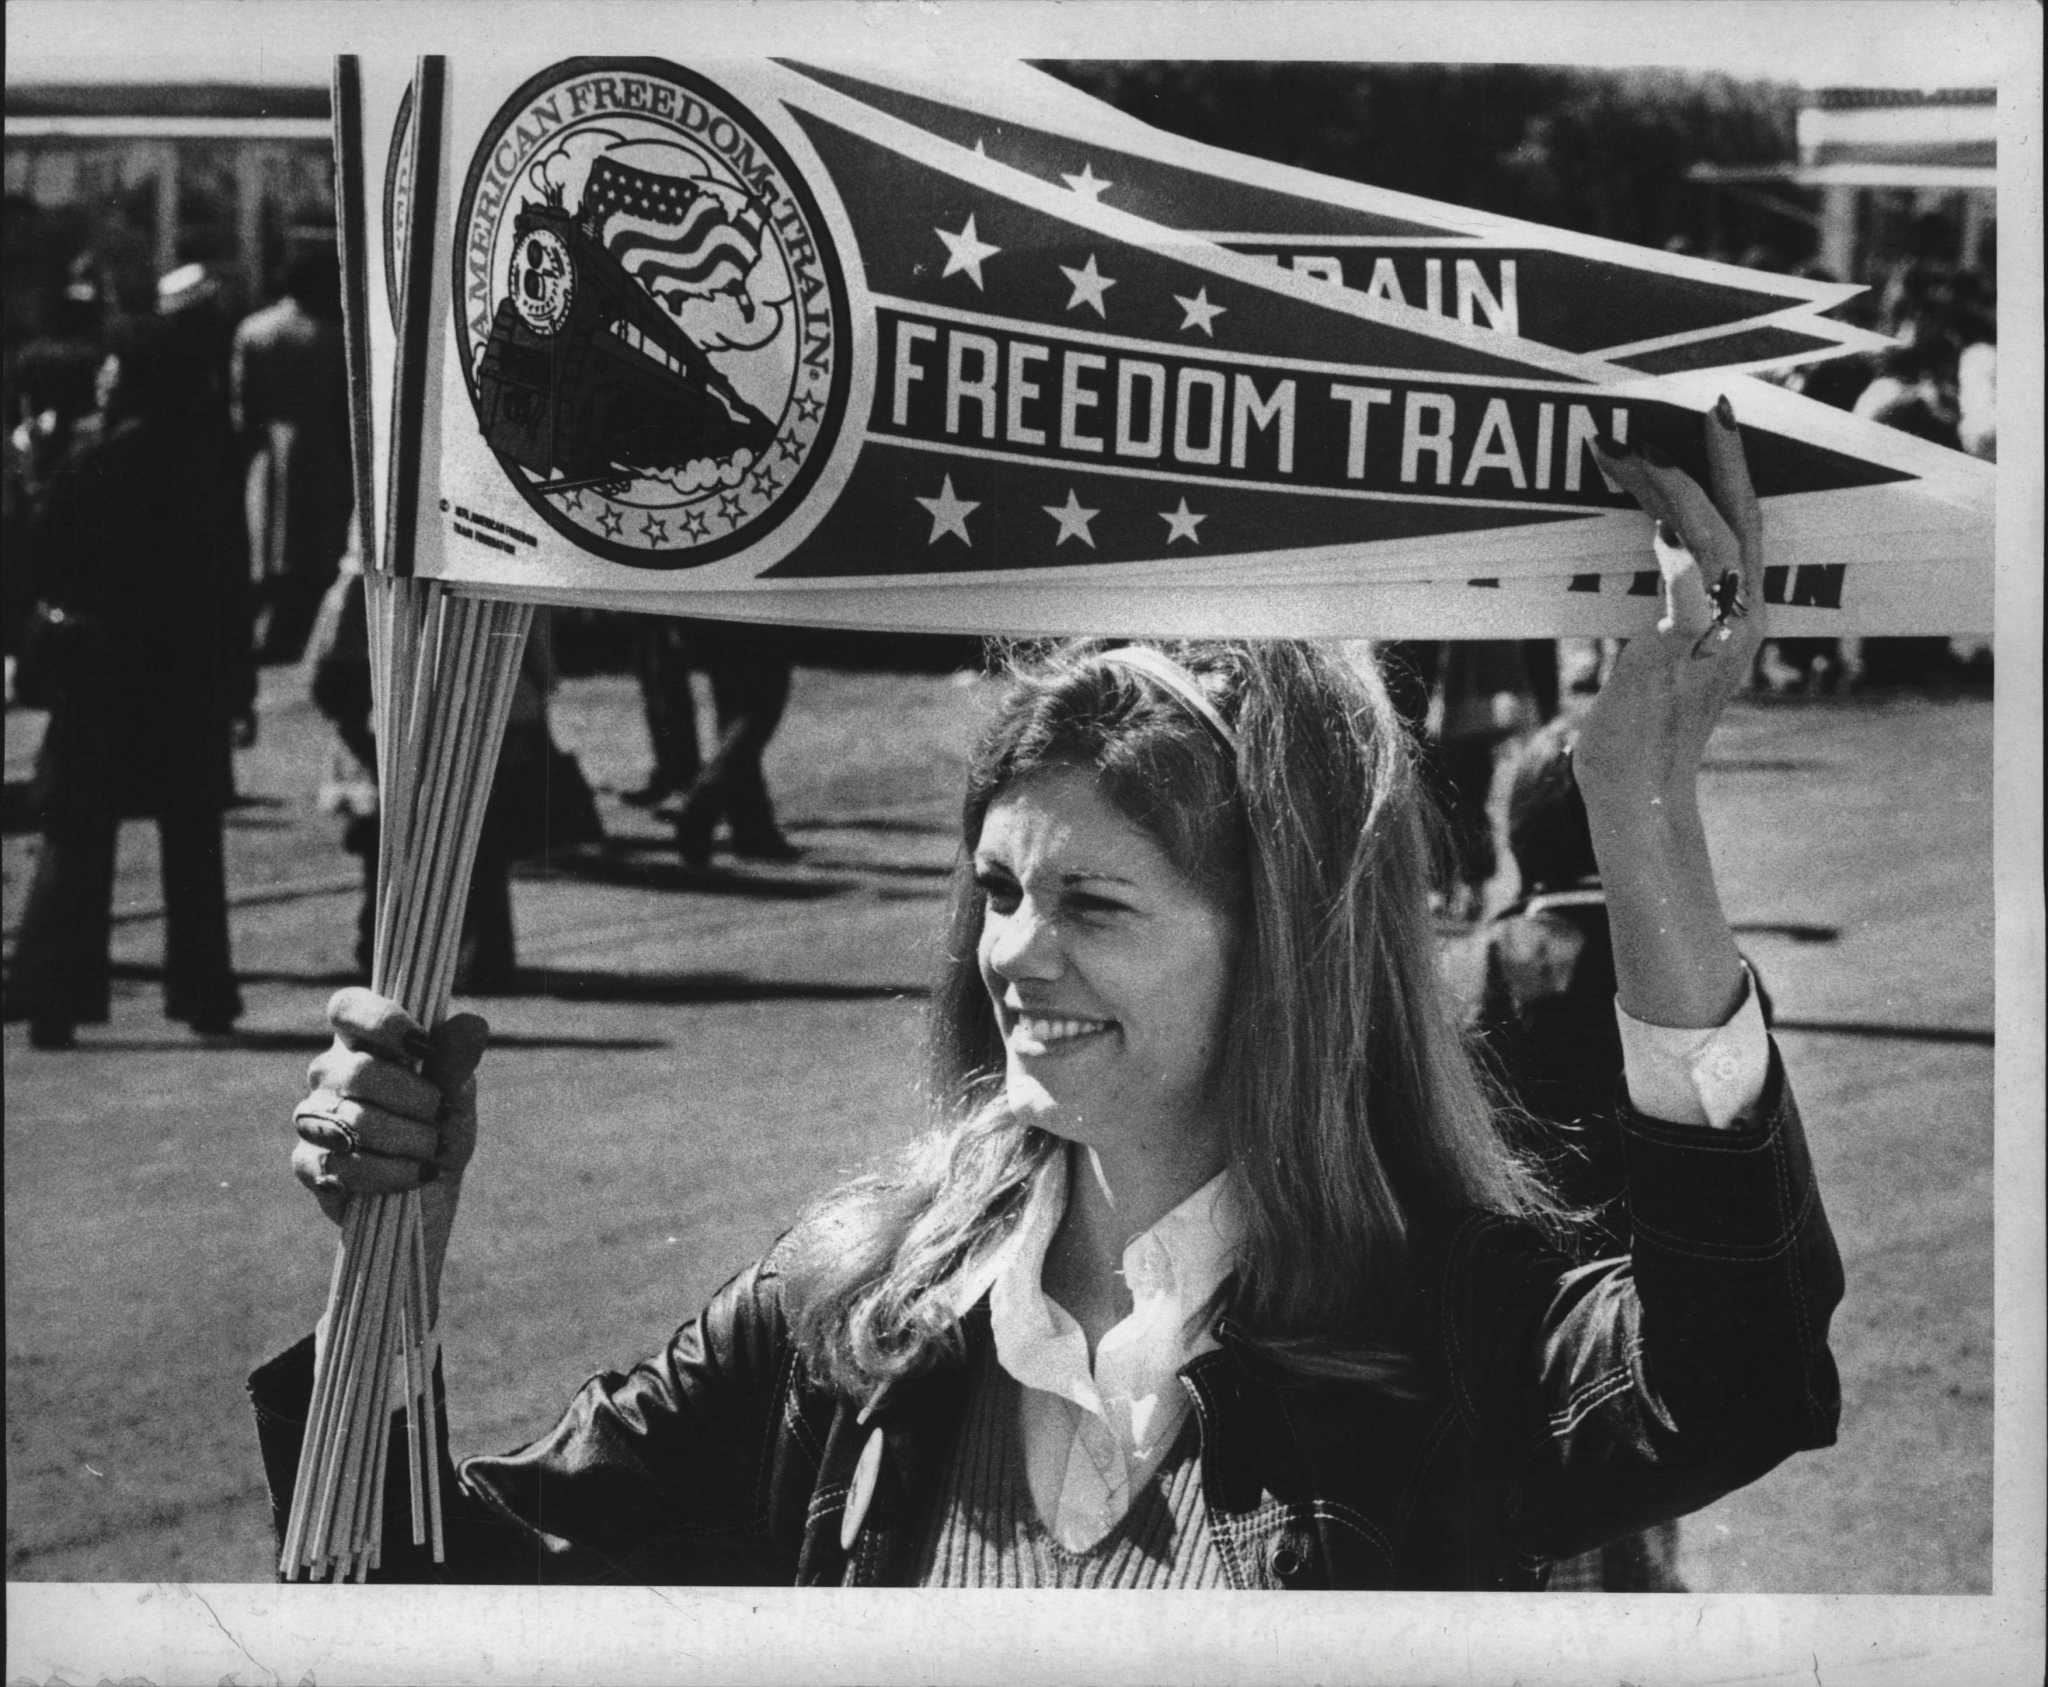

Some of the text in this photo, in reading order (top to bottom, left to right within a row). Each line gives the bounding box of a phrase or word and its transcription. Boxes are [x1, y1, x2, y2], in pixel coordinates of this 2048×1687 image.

[469, 94, 562, 341] AMERICAN
[566, 77, 776, 195] FREEDOM
[1260, 254, 1519, 337] AIN
[893, 319, 1629, 493] FREEDOM TRAIN
